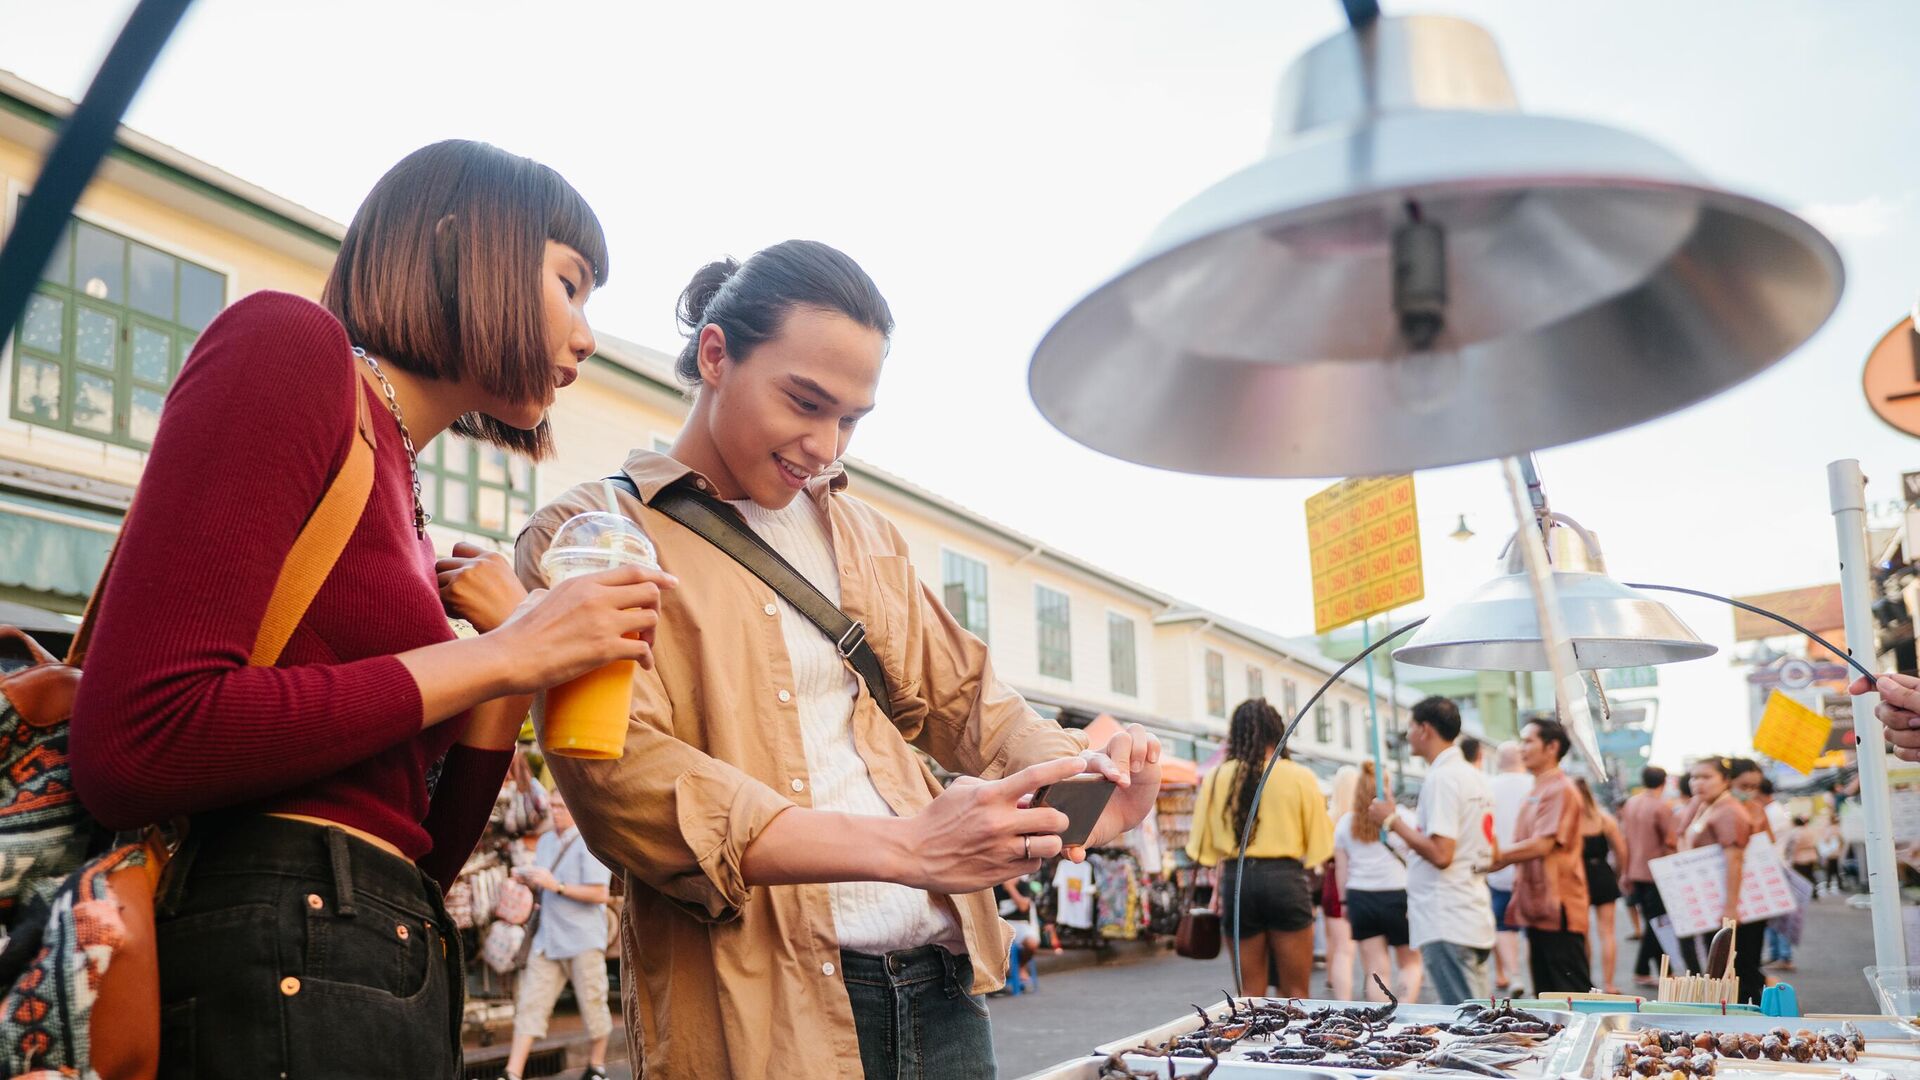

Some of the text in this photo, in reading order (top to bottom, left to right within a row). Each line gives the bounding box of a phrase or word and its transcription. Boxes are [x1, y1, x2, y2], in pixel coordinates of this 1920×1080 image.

[1366, 496, 1385, 517] 200
[1391, 485, 1409, 507] 180
[1368, 525, 1388, 546] 350
[1392, 515, 1412, 537] 300
[1396, 544, 1415, 566] 400
[1398, 575, 1418, 597] 500
